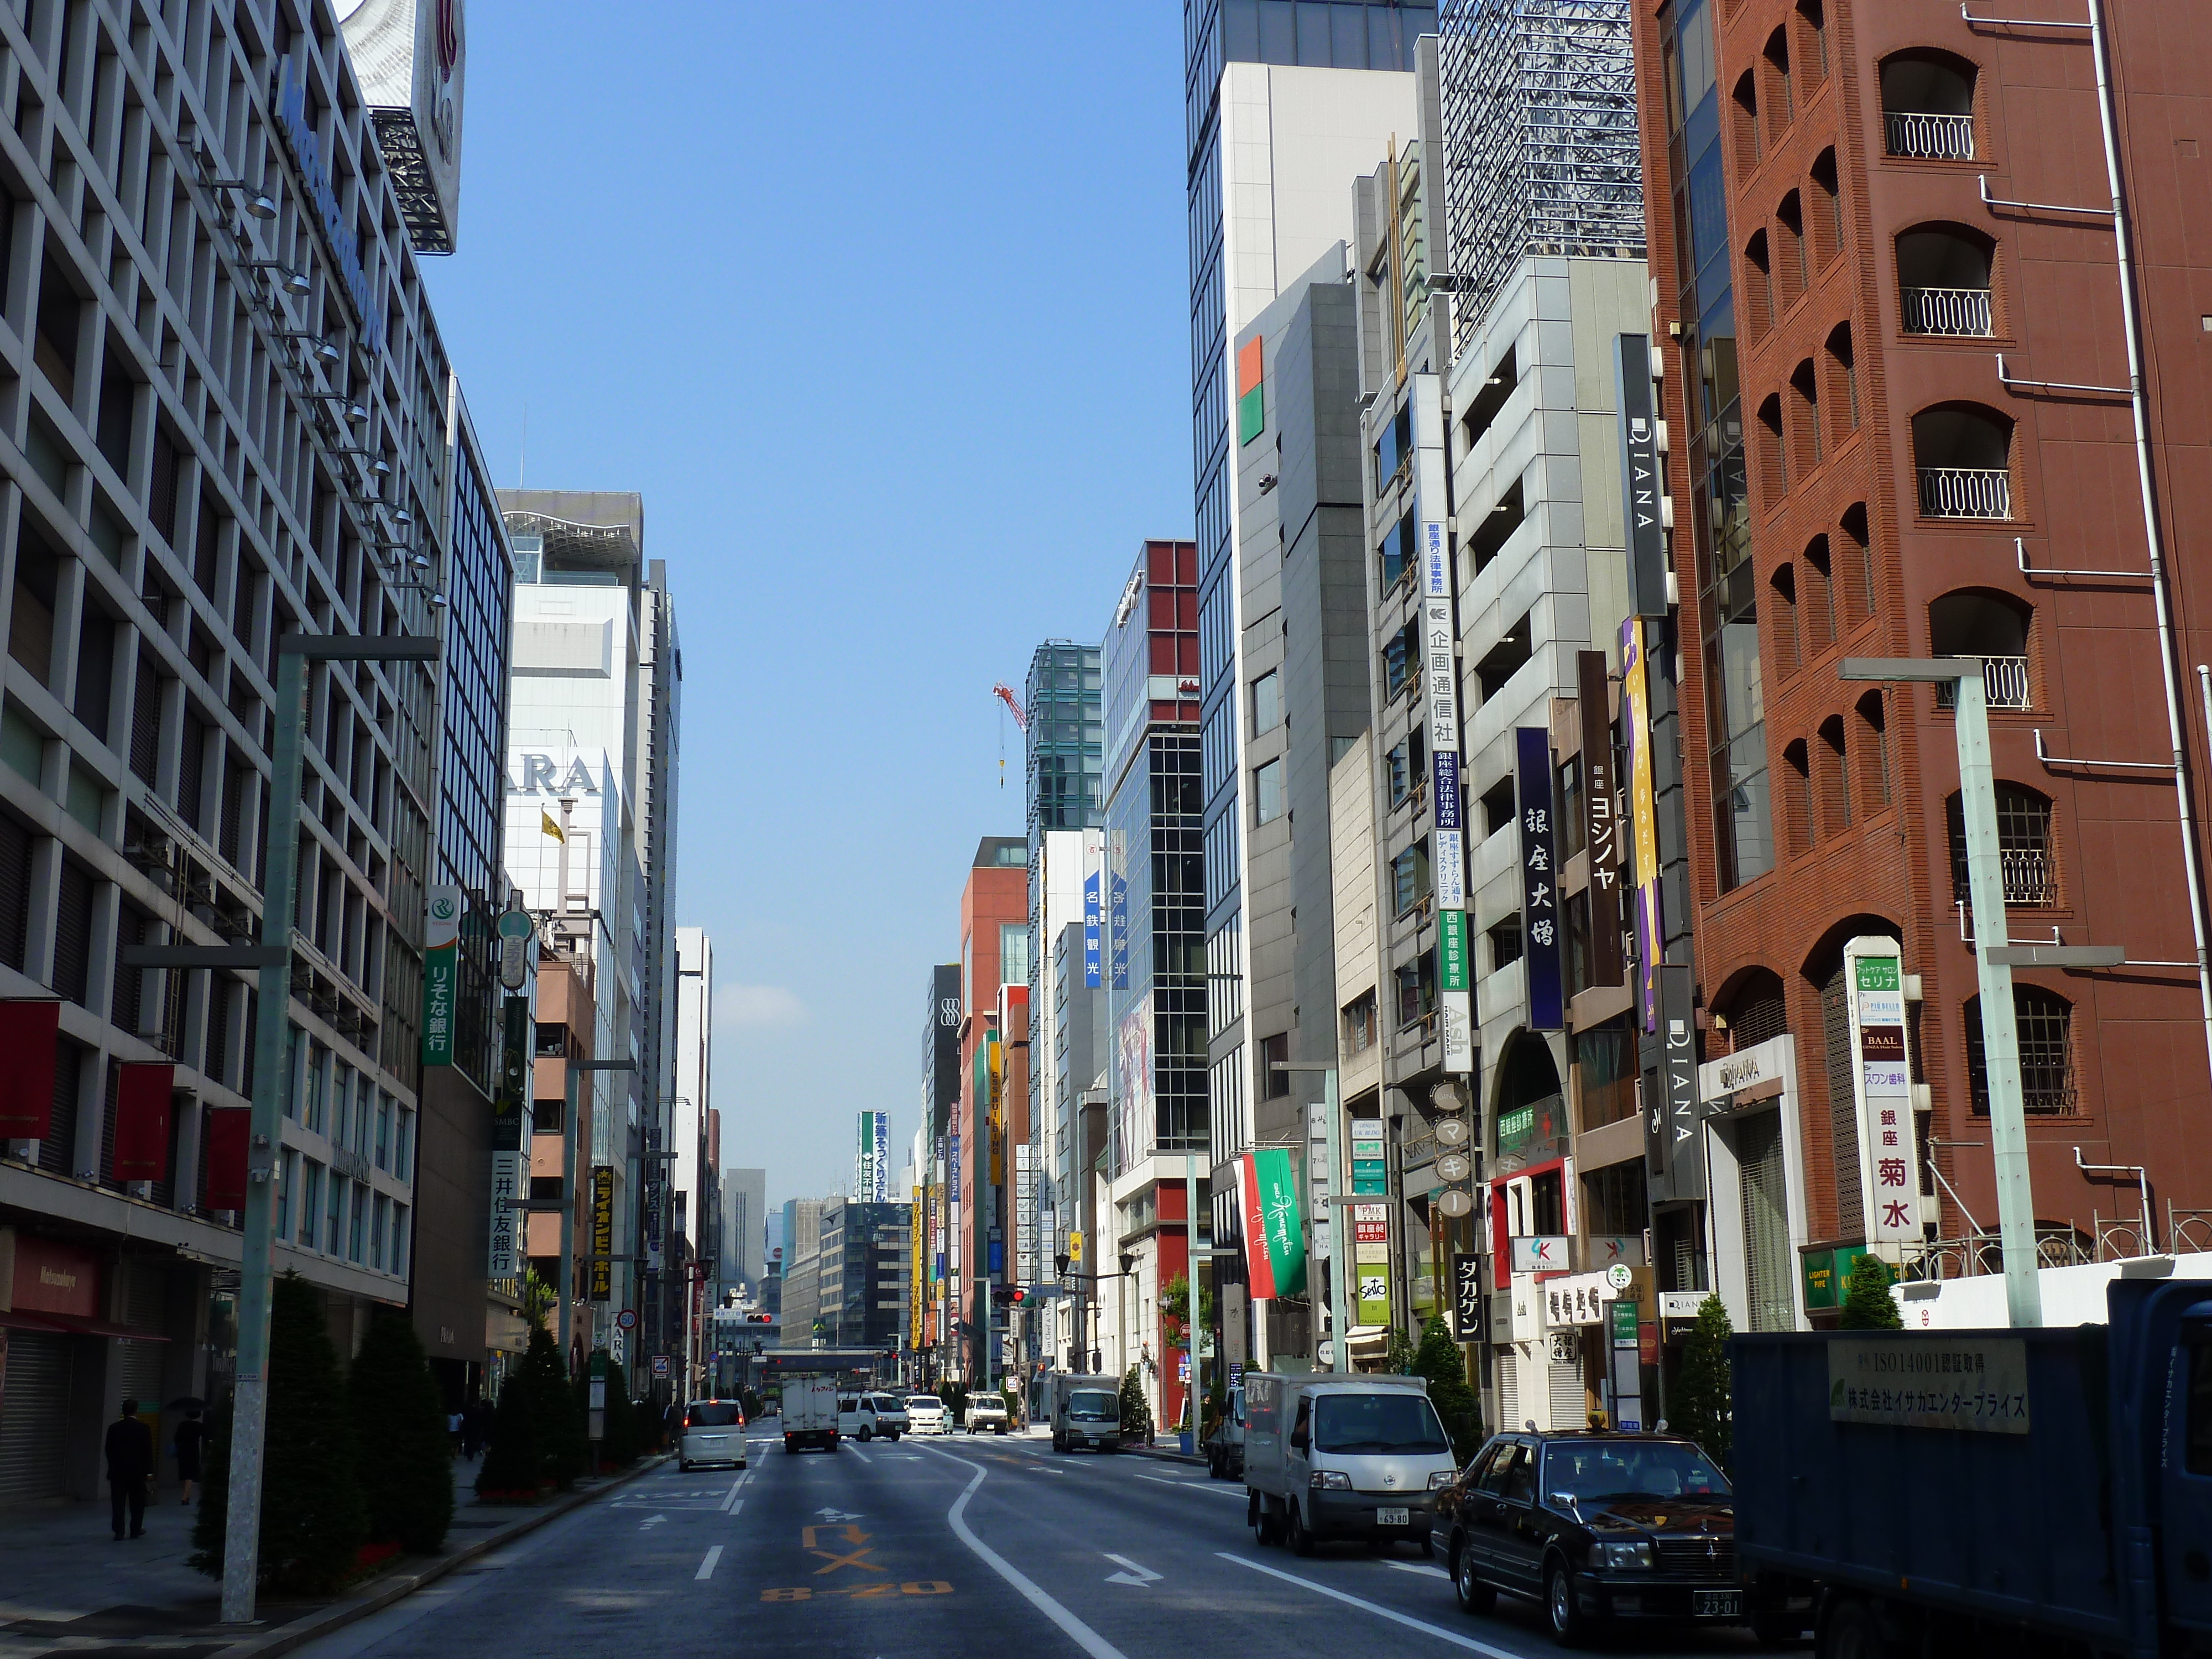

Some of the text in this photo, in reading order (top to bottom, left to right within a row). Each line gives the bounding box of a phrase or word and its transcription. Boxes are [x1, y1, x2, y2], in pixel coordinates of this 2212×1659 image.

[1629, 418, 1653, 528] DIANA
[1428, 524, 1443, 593] 銀座通り法律事務所
[1430, 630, 1453, 742] 企画通信社
[1438, 752, 1455, 827] 銀座総合法律事務所
[1591, 765, 1615, 890] 銀座ヨシノヤ
[1438, 833, 1448, 903] レディスクリニック
[1449, 833, 1461, 904] 銀座すずらん通り
[1525, 808, 1554, 946] 銀座大増
[1086, 891, 1099, 974] 名鉄観光
[1447, 912, 1459, 987] 西銀座診療所
[428, 967, 448, 1052] りそな銀行
[1860, 976, 1896, 987] セリナ
[1449, 1005, 1468, 1056] Ash
[1667, 1020, 1693, 1142] DIANA
[1865, 1073, 1905, 1084] スワン歯科
[494, 1118, 519, 1126] SMBC
[1500, 1109, 1533, 1137] 西銀座診療所
[863, 1161, 872, 1202] 住友不動産
[875, 1112, 887, 1202] 新築そっくりさん
[1443, 1123, 1461, 1212] マギー
[1879, 1110, 1911, 1228] 銀座菊水
[493, 1157, 513, 1271] 三井住友銀行
[649, 1182, 659, 1208] ダンス
[1459, 1262, 1478, 1334] タカゲン
[1809, 1270, 1830, 1279] LIGHTER
[1814, 1280, 1826, 1288] PIPE
[621, 1315, 633, 1324] 50
[1669, 1300, 1703, 1310] DIAN
[613, 1320, 623, 1363] ARA
[1874, 1353, 1984, 1374] ISO14001認証取得
[1848, 1387, 2026, 1418] 株式会社イサカエンタープライズ
[1384, 1515, 1407, 1524] 69-80
[760, 1580, 954, 1601] 8-20
[1704, 1601, 1738, 1614] 23-01
